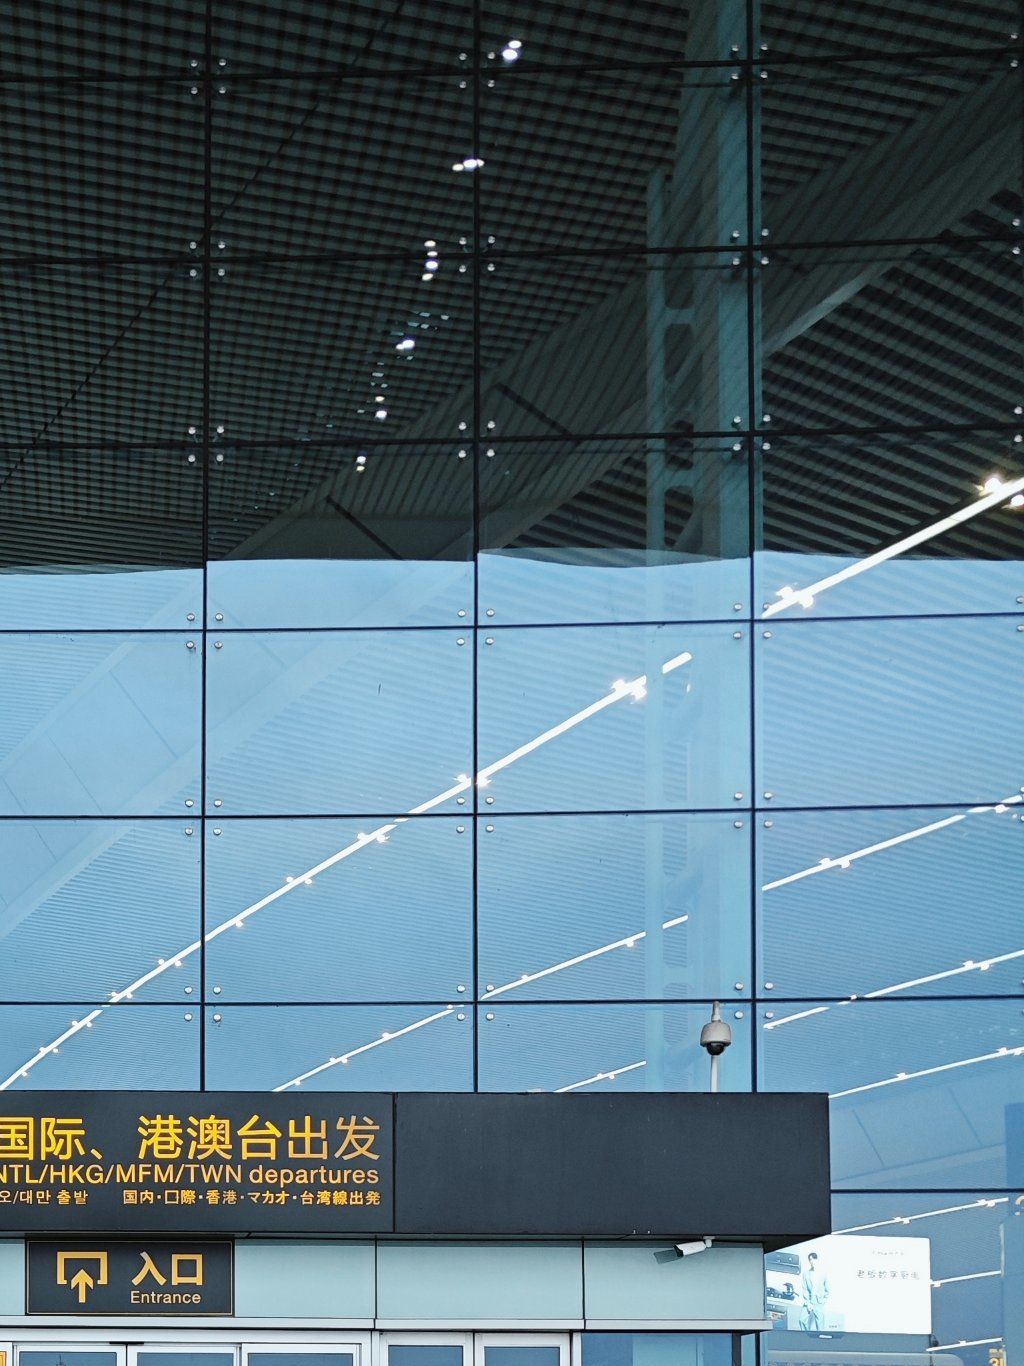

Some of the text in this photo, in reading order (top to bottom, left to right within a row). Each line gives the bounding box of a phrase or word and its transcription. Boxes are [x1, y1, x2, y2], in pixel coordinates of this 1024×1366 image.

[248, 1164, 380, 1188] departures
[56, 1189, 89, 1206] 출발
[131, 1251, 203, 1286] 入口
[130, 1290, 202, 1304] Entrance
